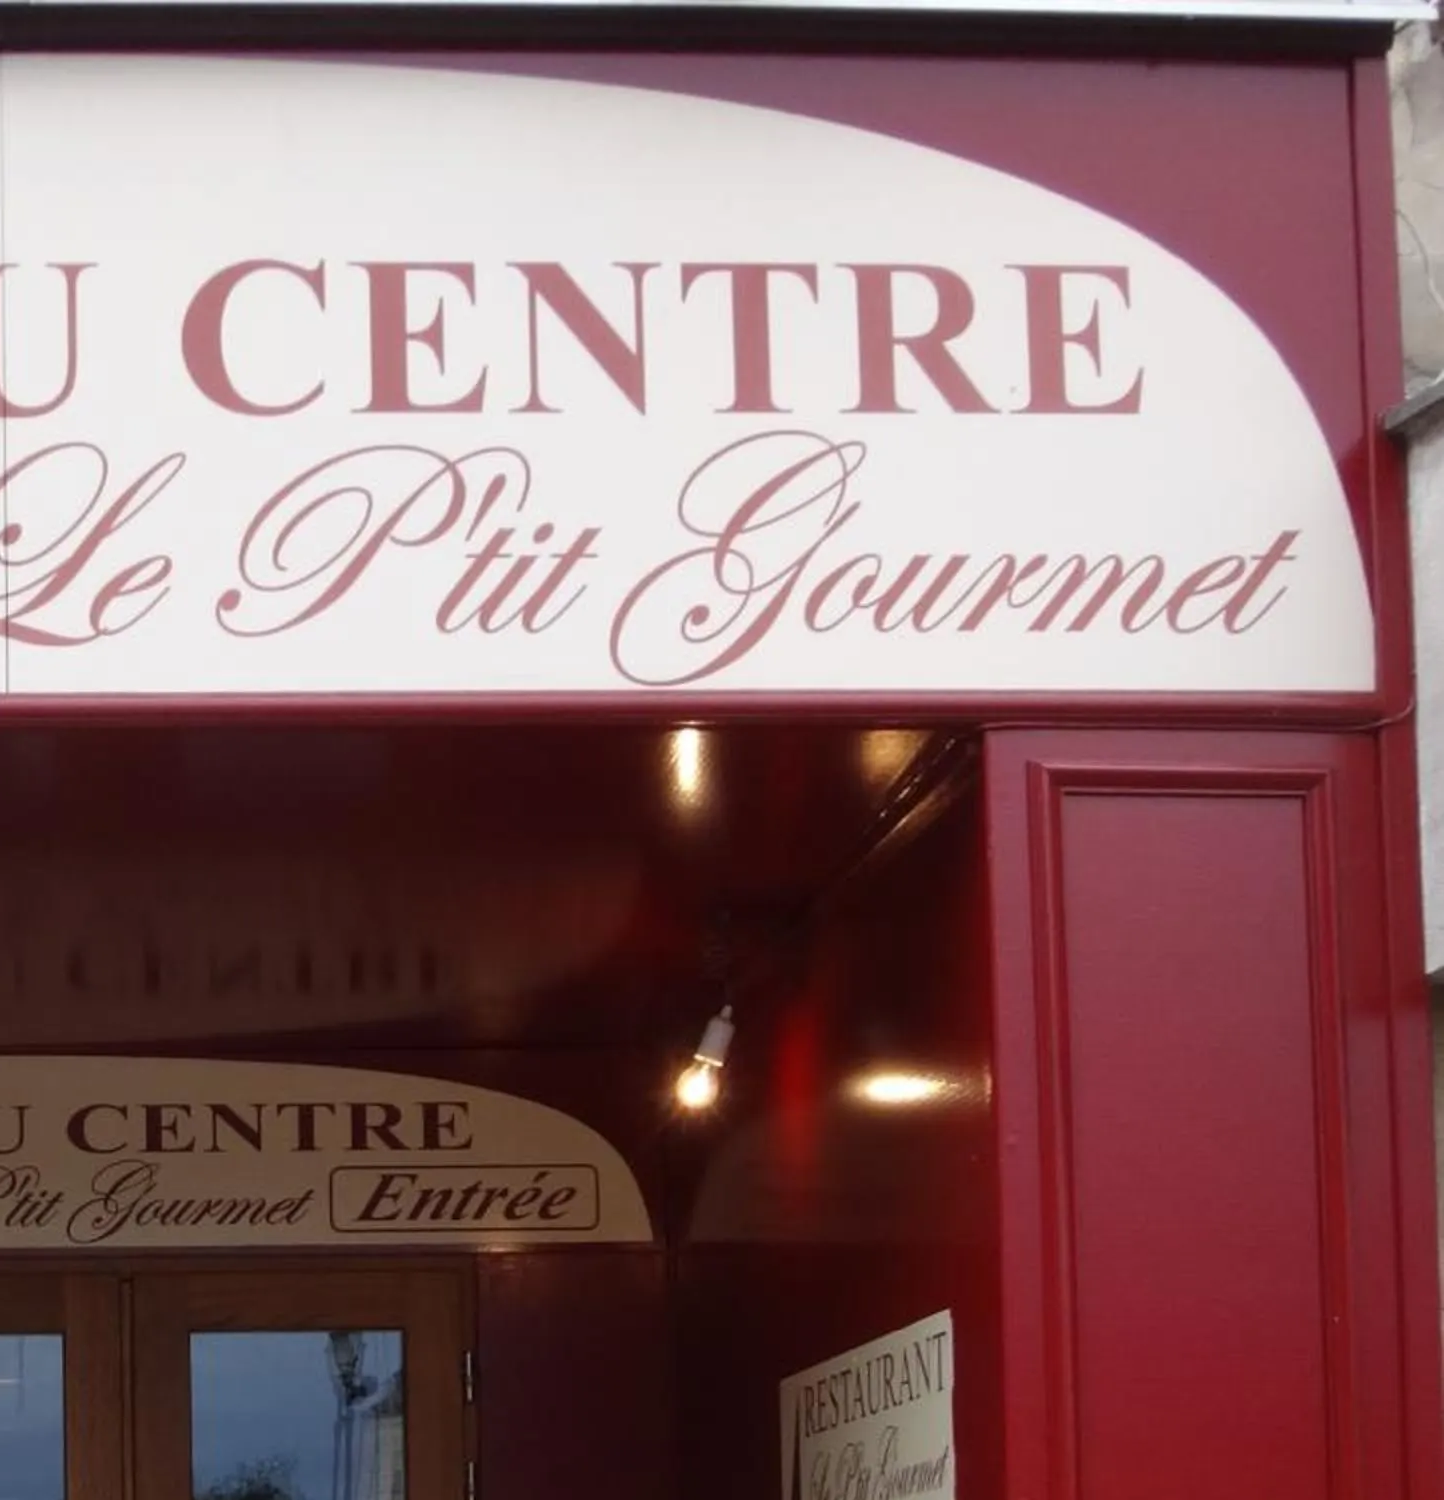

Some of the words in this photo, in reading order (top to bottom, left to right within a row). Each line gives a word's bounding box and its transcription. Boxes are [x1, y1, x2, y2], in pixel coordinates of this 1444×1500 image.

[181, 258, 1146, 417] CENTRE
[214, 443, 604, 639] P'tit
[608, 429, 1304, 687] Gourmet
[66, 1102, 473, 1155] CENTRE
[66, 1158, 315, 1245] Gourmet
[355, 1171, 577, 1225] Entrée
[804, 1331, 947, 1438] RESTAURANT
